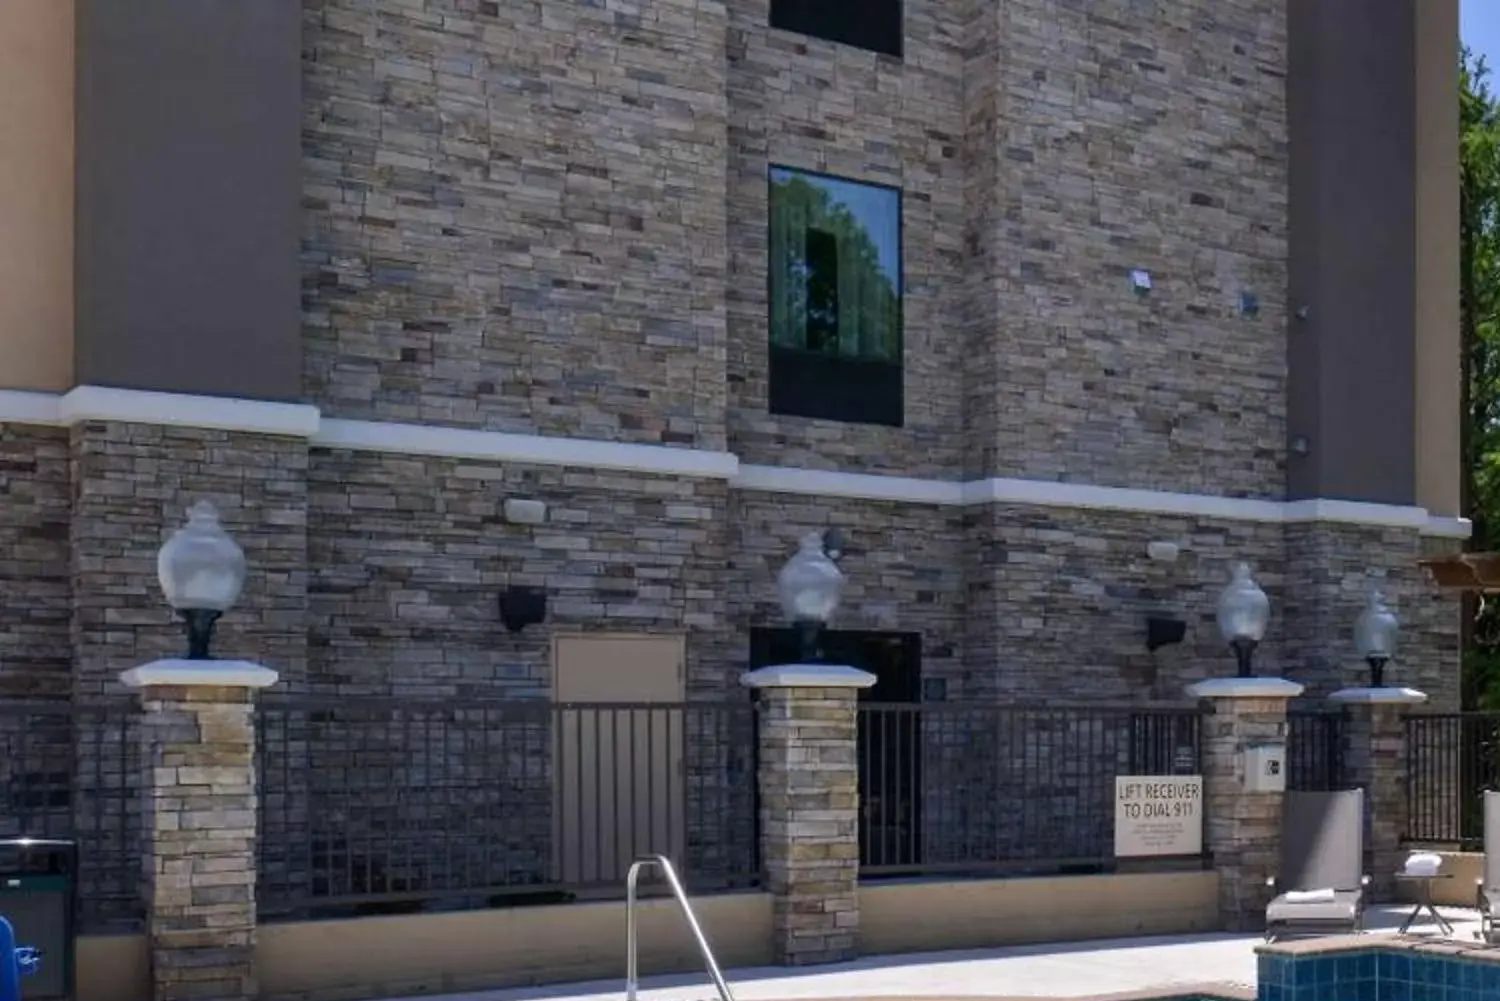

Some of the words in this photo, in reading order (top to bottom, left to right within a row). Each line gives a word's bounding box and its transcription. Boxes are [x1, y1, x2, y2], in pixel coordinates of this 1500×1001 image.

[1119, 783, 1142, 799] LIFT
[1145, 783, 1200, 800] RECEIVER
[1123, 802, 1141, 818] TO
[1144, 802, 1171, 818] DIAL
[1174, 801, 1194, 817] 911
